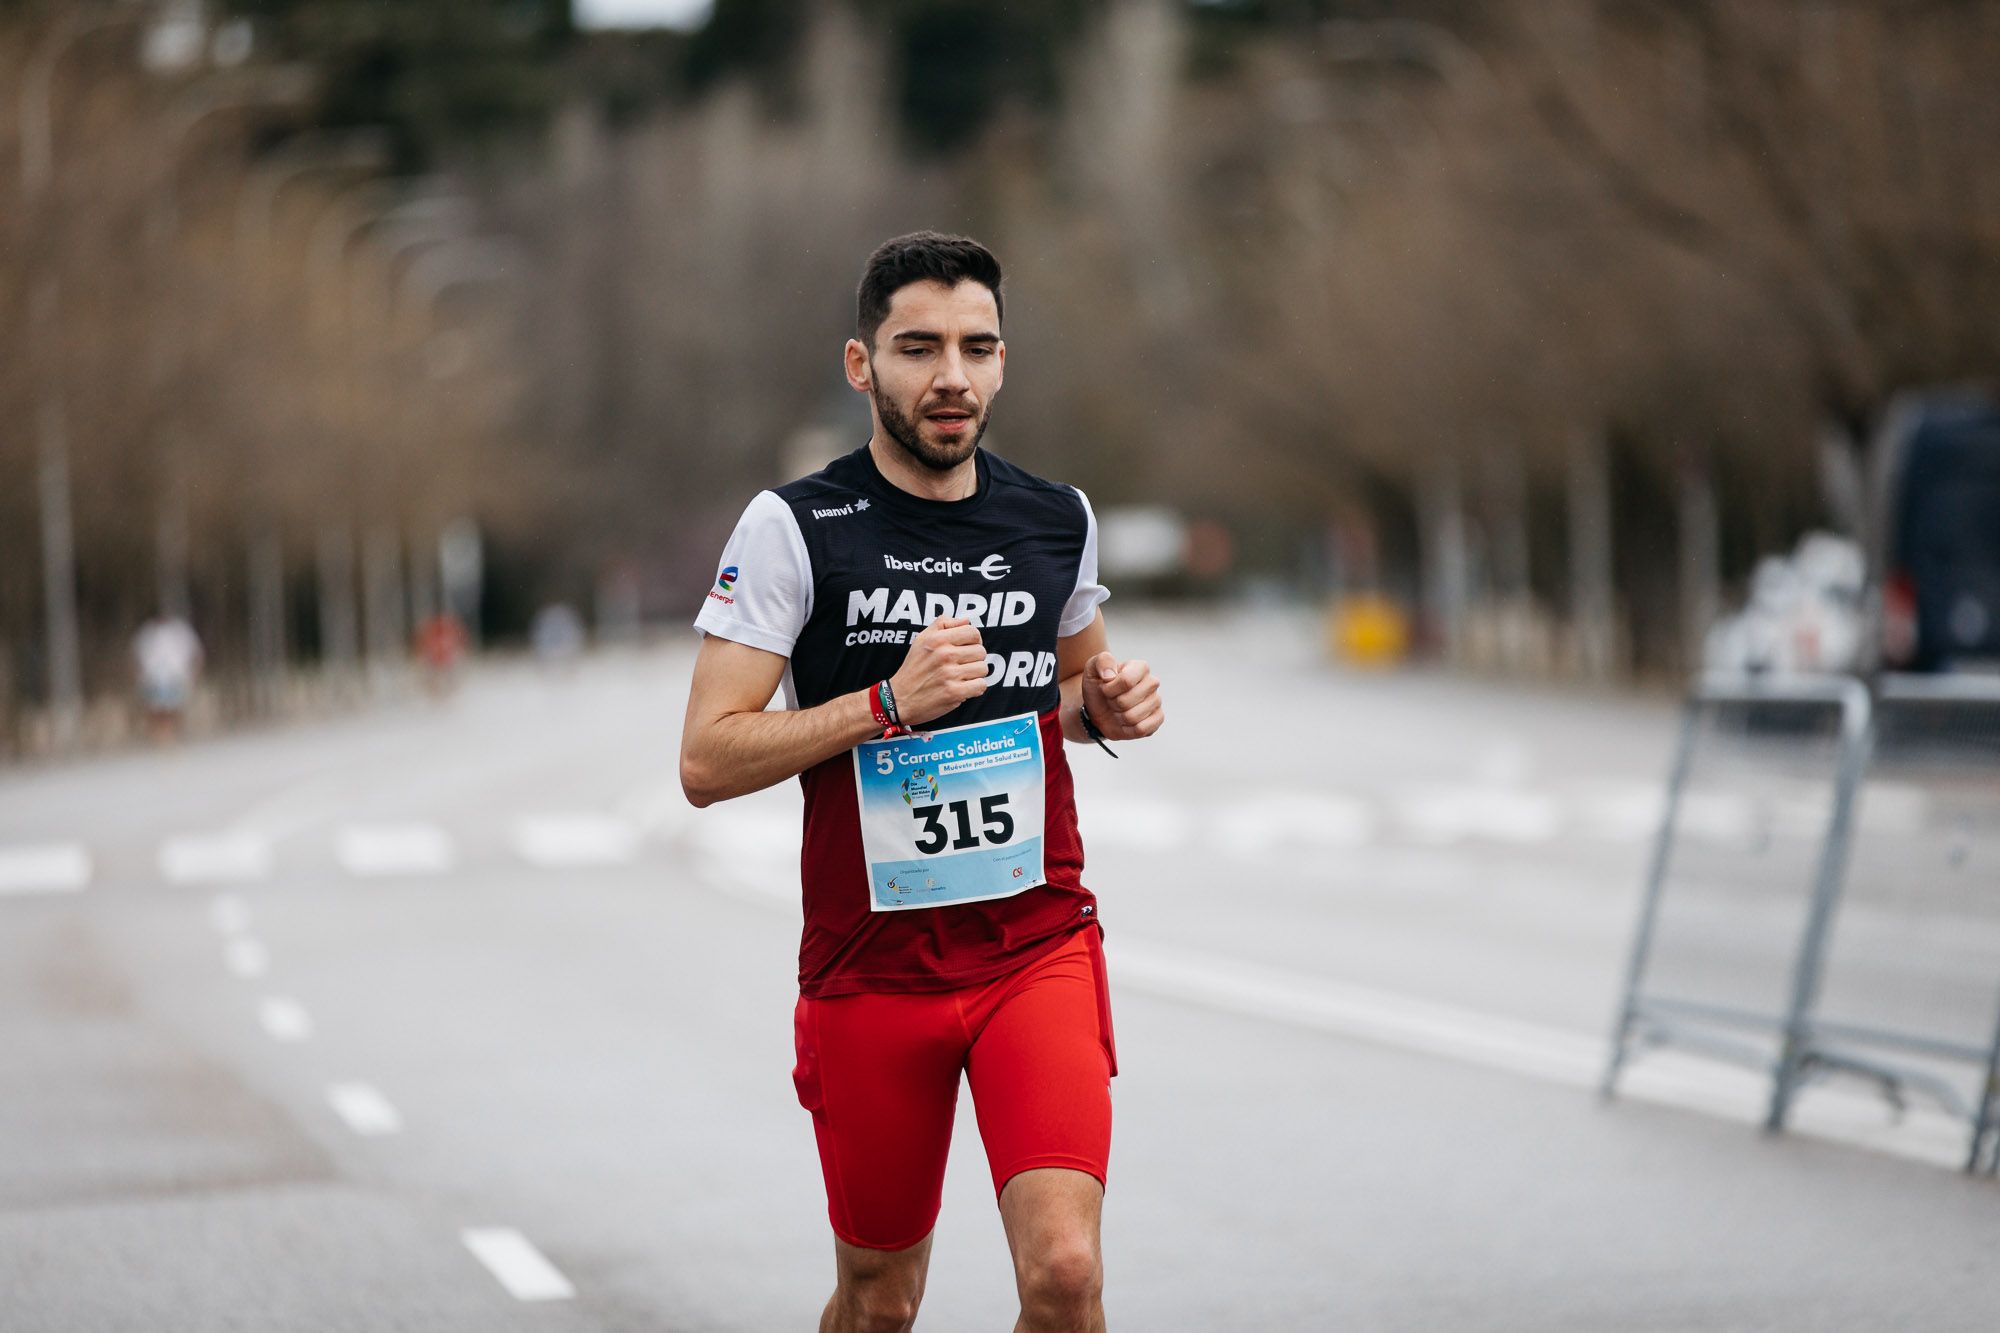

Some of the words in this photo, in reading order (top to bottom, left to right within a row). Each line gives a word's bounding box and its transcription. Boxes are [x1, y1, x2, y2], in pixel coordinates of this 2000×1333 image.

[846, 588, 1036, 628] MADRID
[845, 629, 908, 646] CORRE
[985, 651, 1056, 687] DRID
[898, 750, 954, 765] Carrera
[957, 736, 1015, 757] Solidaria
[995, 754, 1012, 762] Salud
[913, 793, 1015, 855] 315
